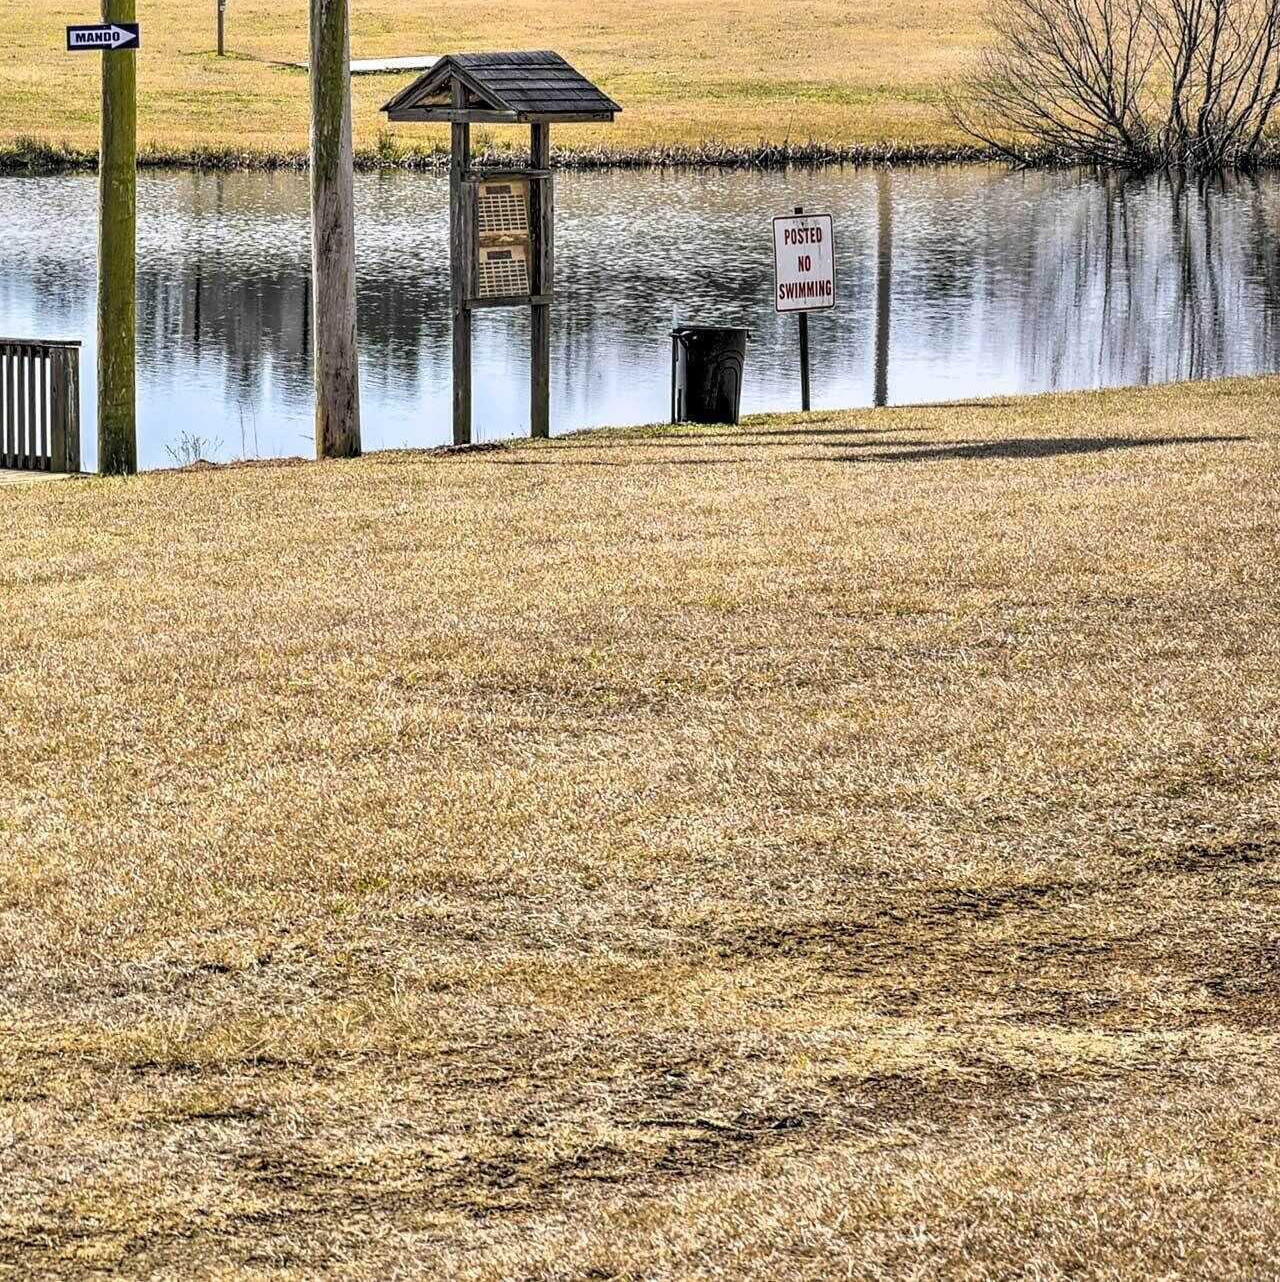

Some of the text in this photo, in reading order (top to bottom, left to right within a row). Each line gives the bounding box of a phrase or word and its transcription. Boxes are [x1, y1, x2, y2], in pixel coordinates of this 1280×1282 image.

[75, 31, 120, 43] MANDO
[784, 227, 823, 245] POSTED
[798, 255, 811, 272] NO
[779, 280, 832, 300] SWIMMING
